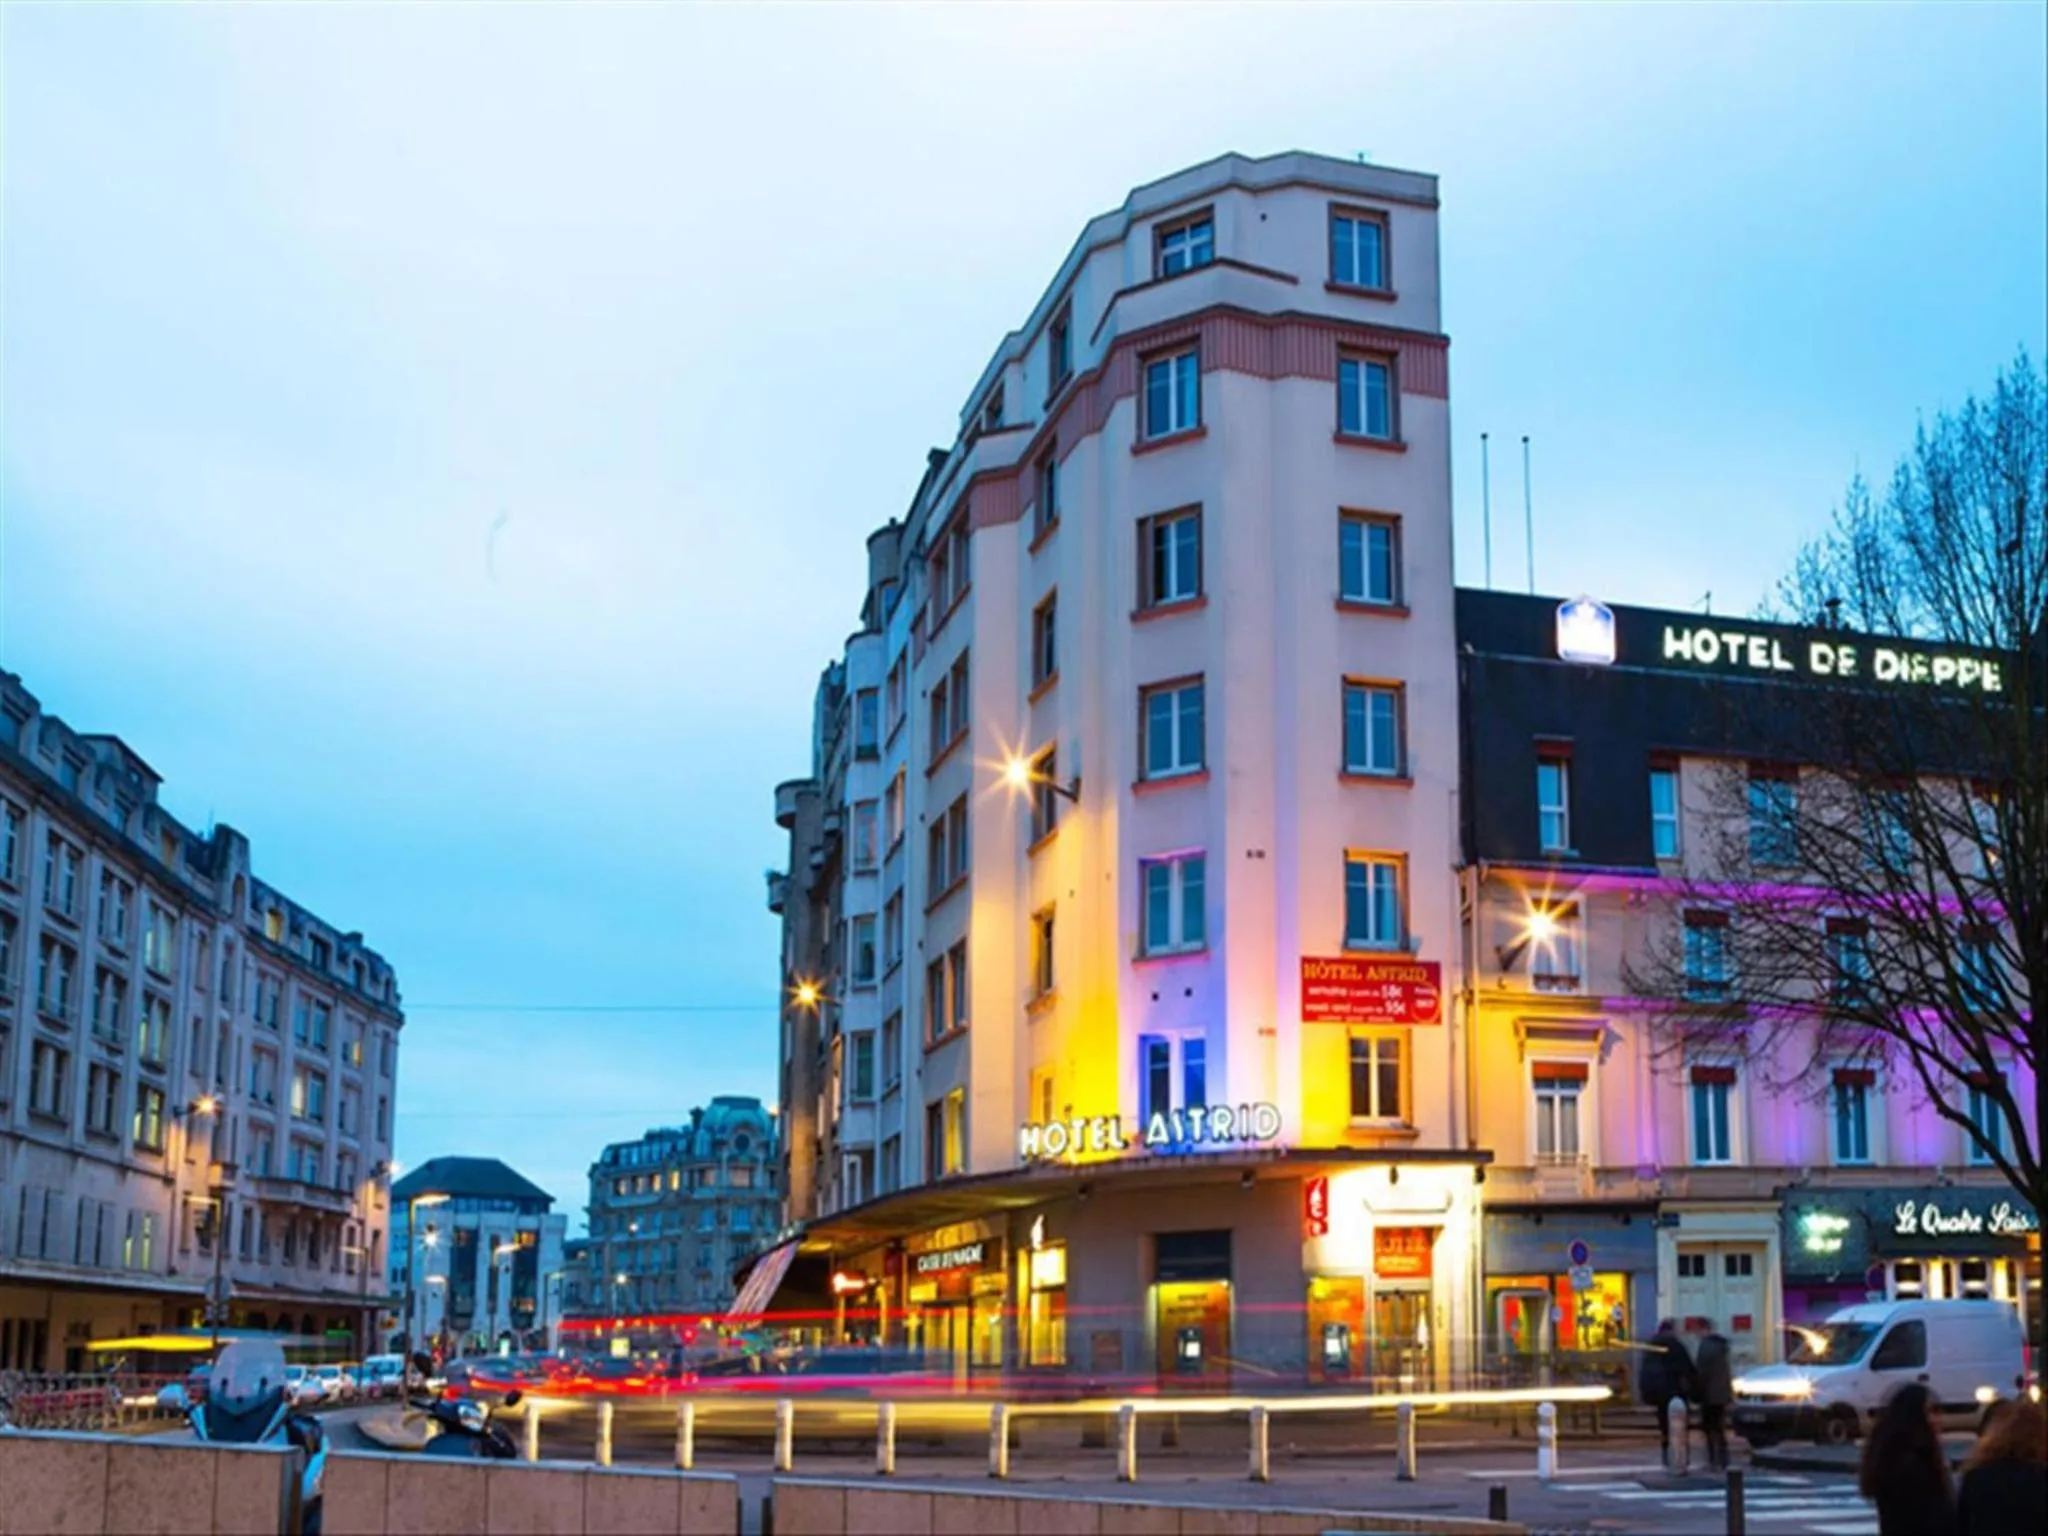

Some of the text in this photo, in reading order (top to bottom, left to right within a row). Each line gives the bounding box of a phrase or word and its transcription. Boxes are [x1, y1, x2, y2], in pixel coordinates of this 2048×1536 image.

[1663, 626, 1795, 672] HOTEL
[1809, 642, 1858, 676] DE
[1366, 965, 1429, 983] ASTRID
[1145, 1103, 1282, 1148] ASTRID
[1894, 1200, 1918, 1234] Le
